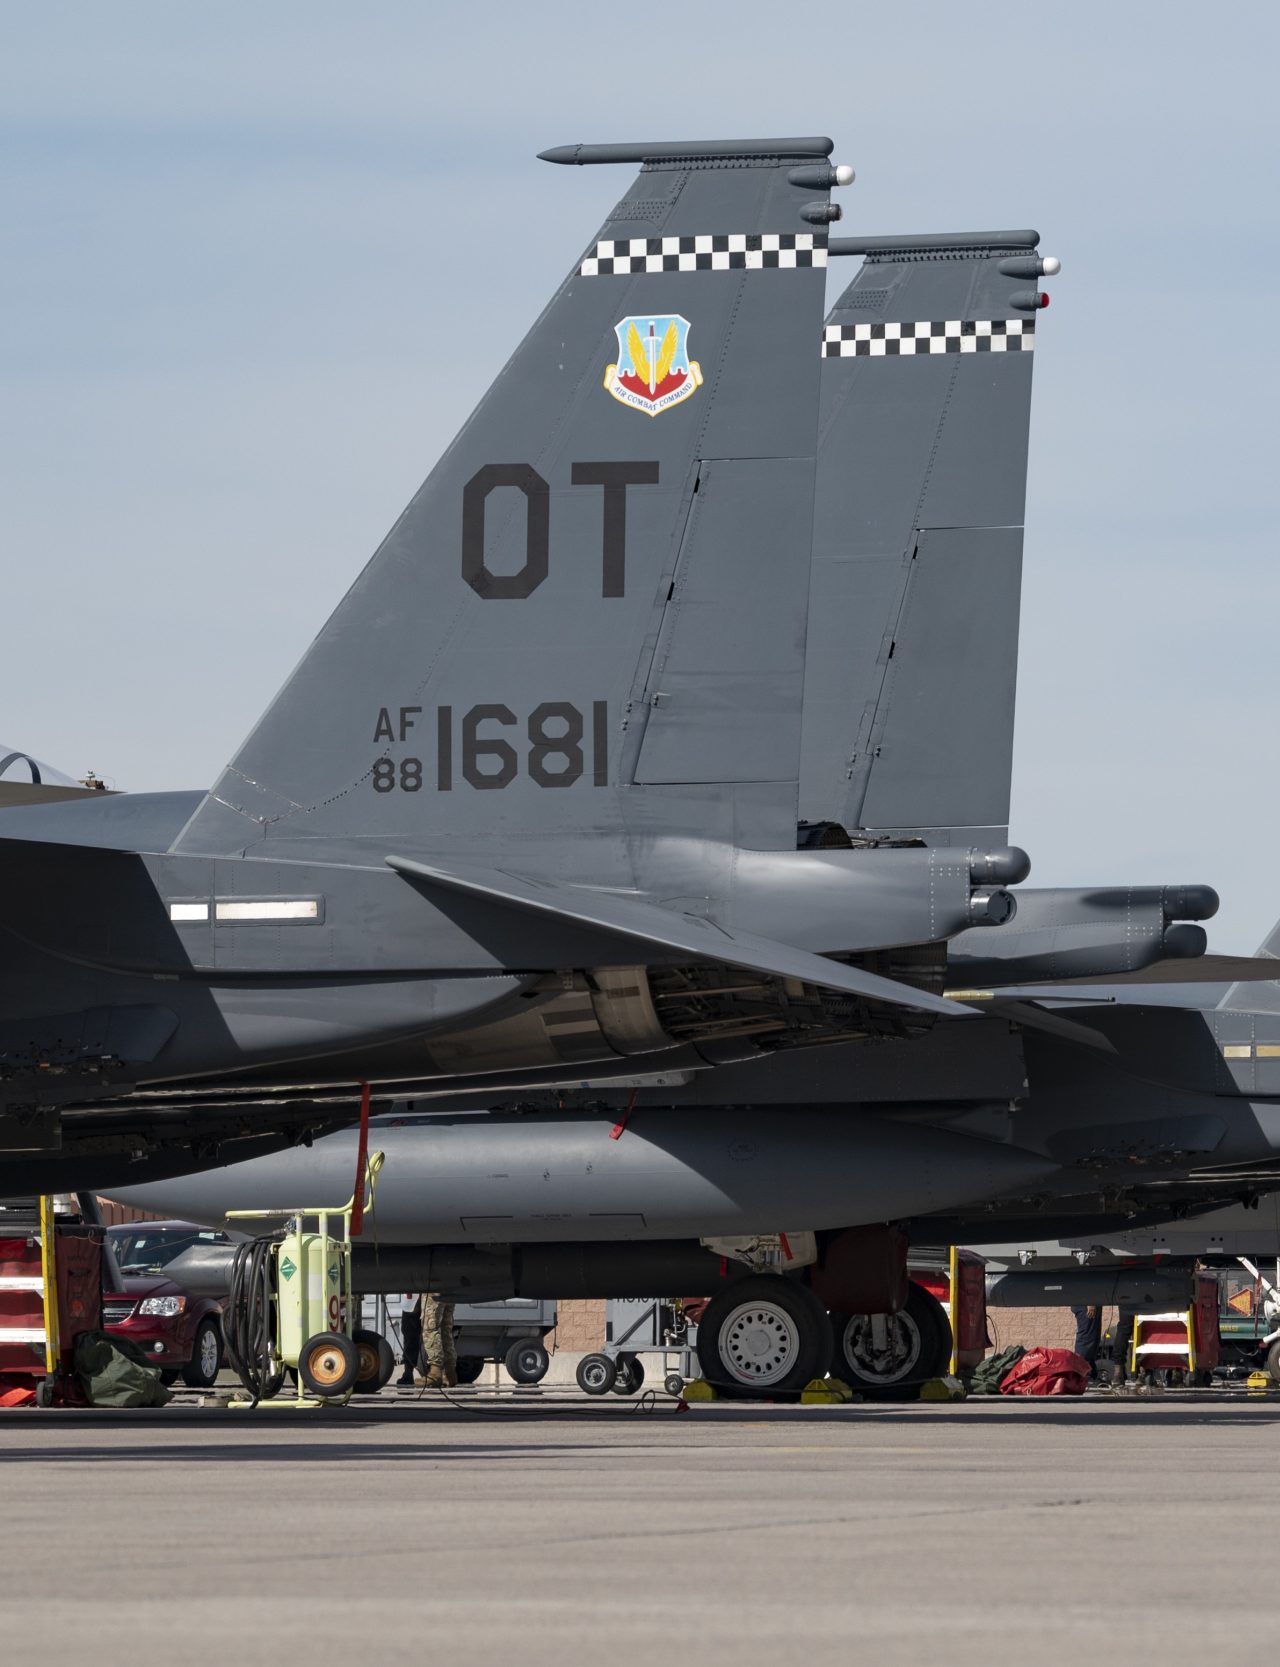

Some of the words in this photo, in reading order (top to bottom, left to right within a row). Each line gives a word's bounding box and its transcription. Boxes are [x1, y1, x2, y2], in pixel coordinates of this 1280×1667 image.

[614, 385, 626, 397] AIR
[627, 394, 657, 411] COMBAT
[659, 382, 693, 407] COMMAND
[461, 460, 660, 600] OT
[373, 706, 422, 742] AF
[437, 700, 609, 792] 1681
[372, 757, 423, 793] 88
